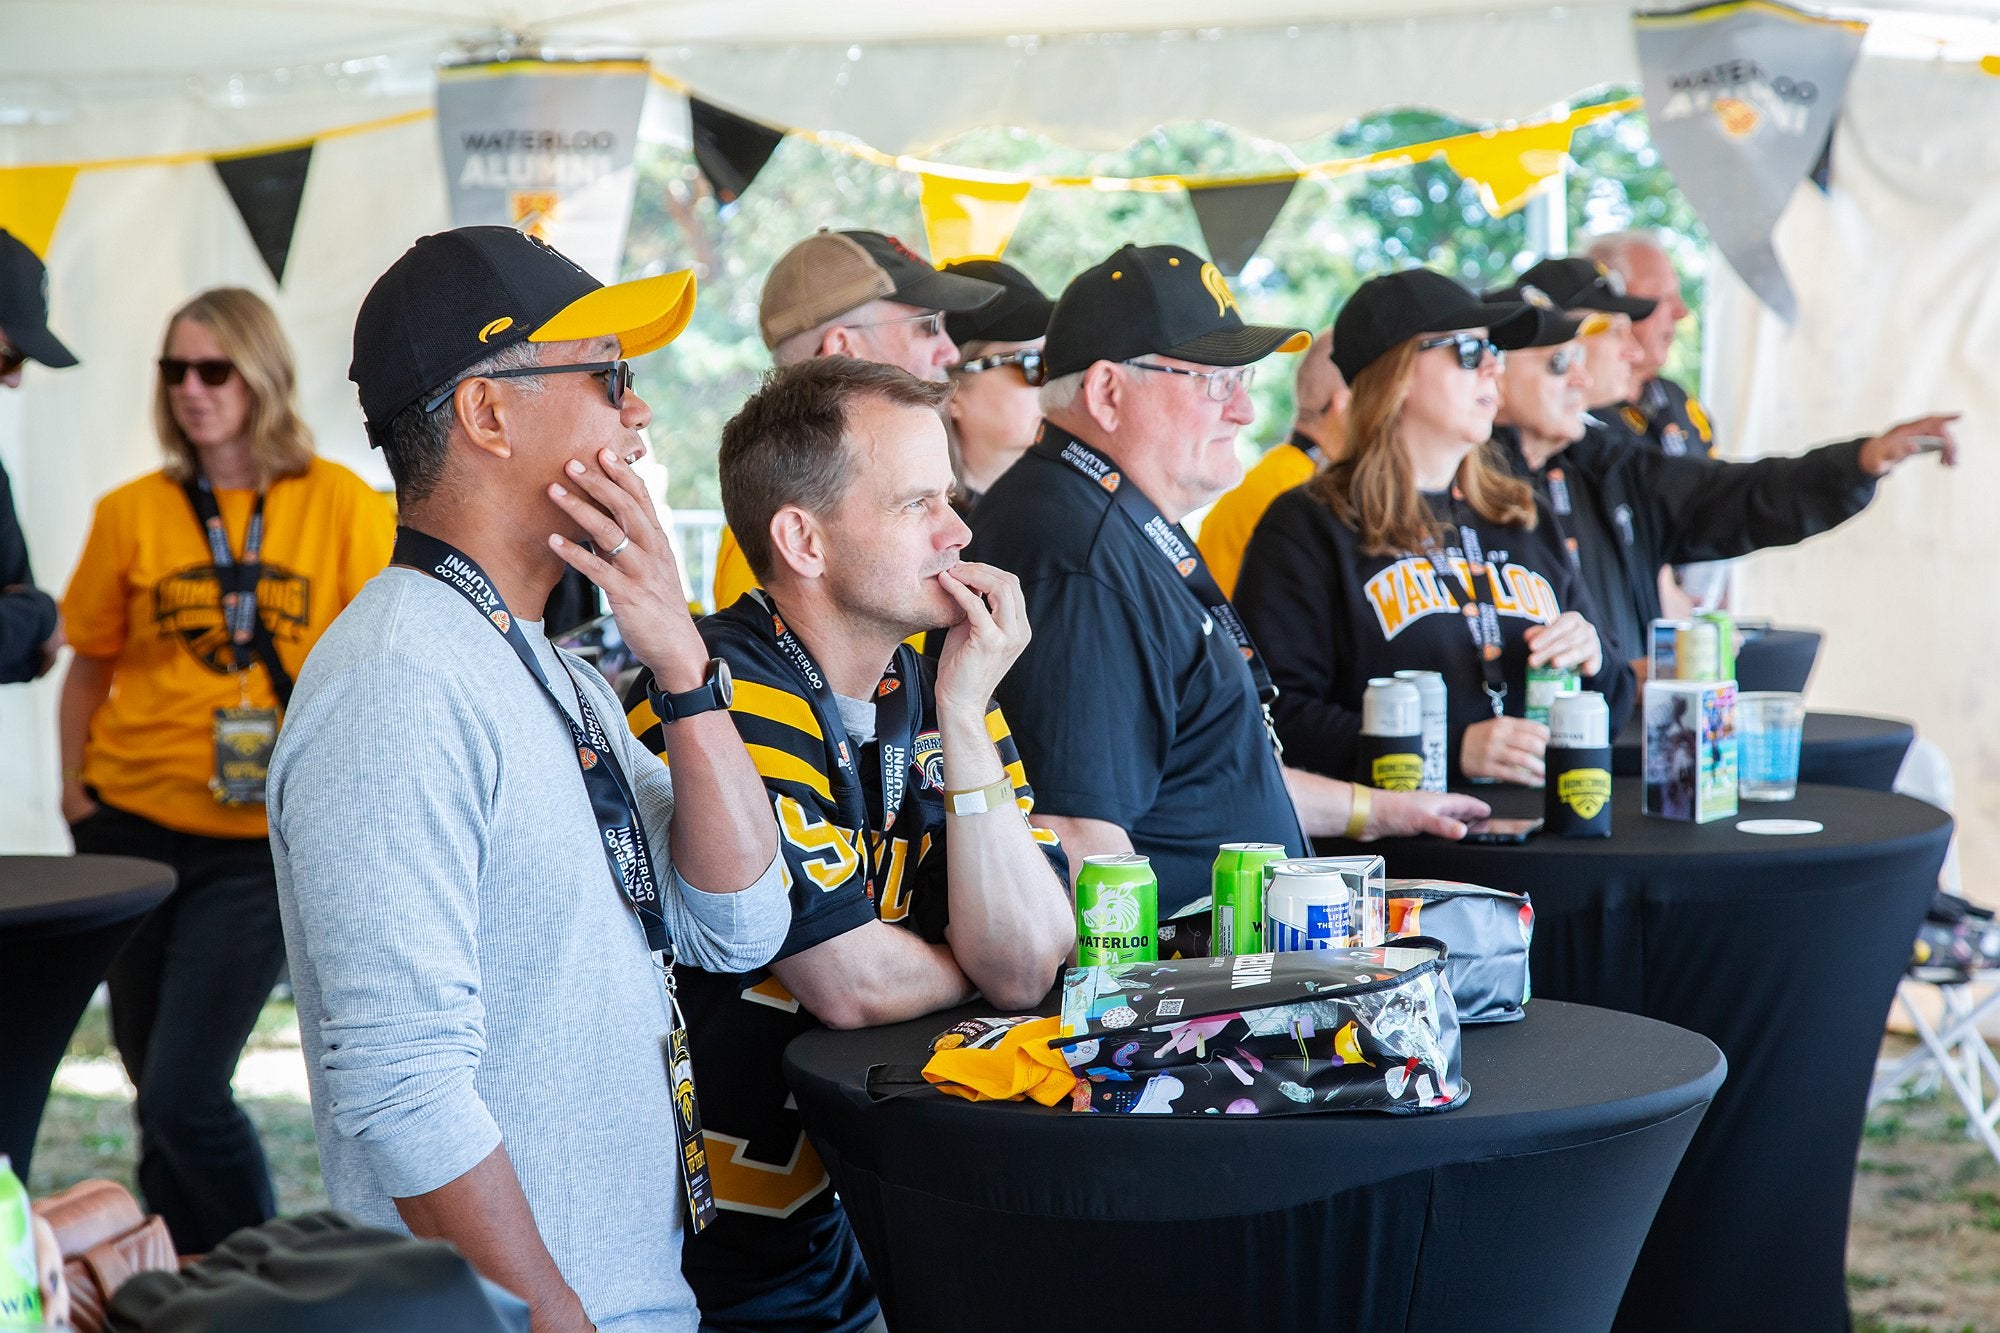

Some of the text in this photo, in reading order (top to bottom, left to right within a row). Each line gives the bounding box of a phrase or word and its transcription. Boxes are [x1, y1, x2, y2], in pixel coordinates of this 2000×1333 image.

[461, 129, 619, 151] WATERLOO
[1061, 449, 1102, 481] WATERLOO
[1067, 441, 1110, 473] ALUMNI
[1144, 522, 1180, 566] WATERLOO
[1153, 515, 1190, 556] ALUMNI
[434, 564, 493, 615] WATERLOO
[442, 554, 500, 608] ALUMNI
[783, 631, 823, 690] WATERLOO
[884, 744, 894, 810] WATERLOO
[893, 747, 905, 811] ALUMNI
[1078, 935, 1149, 949] WATERLOO
